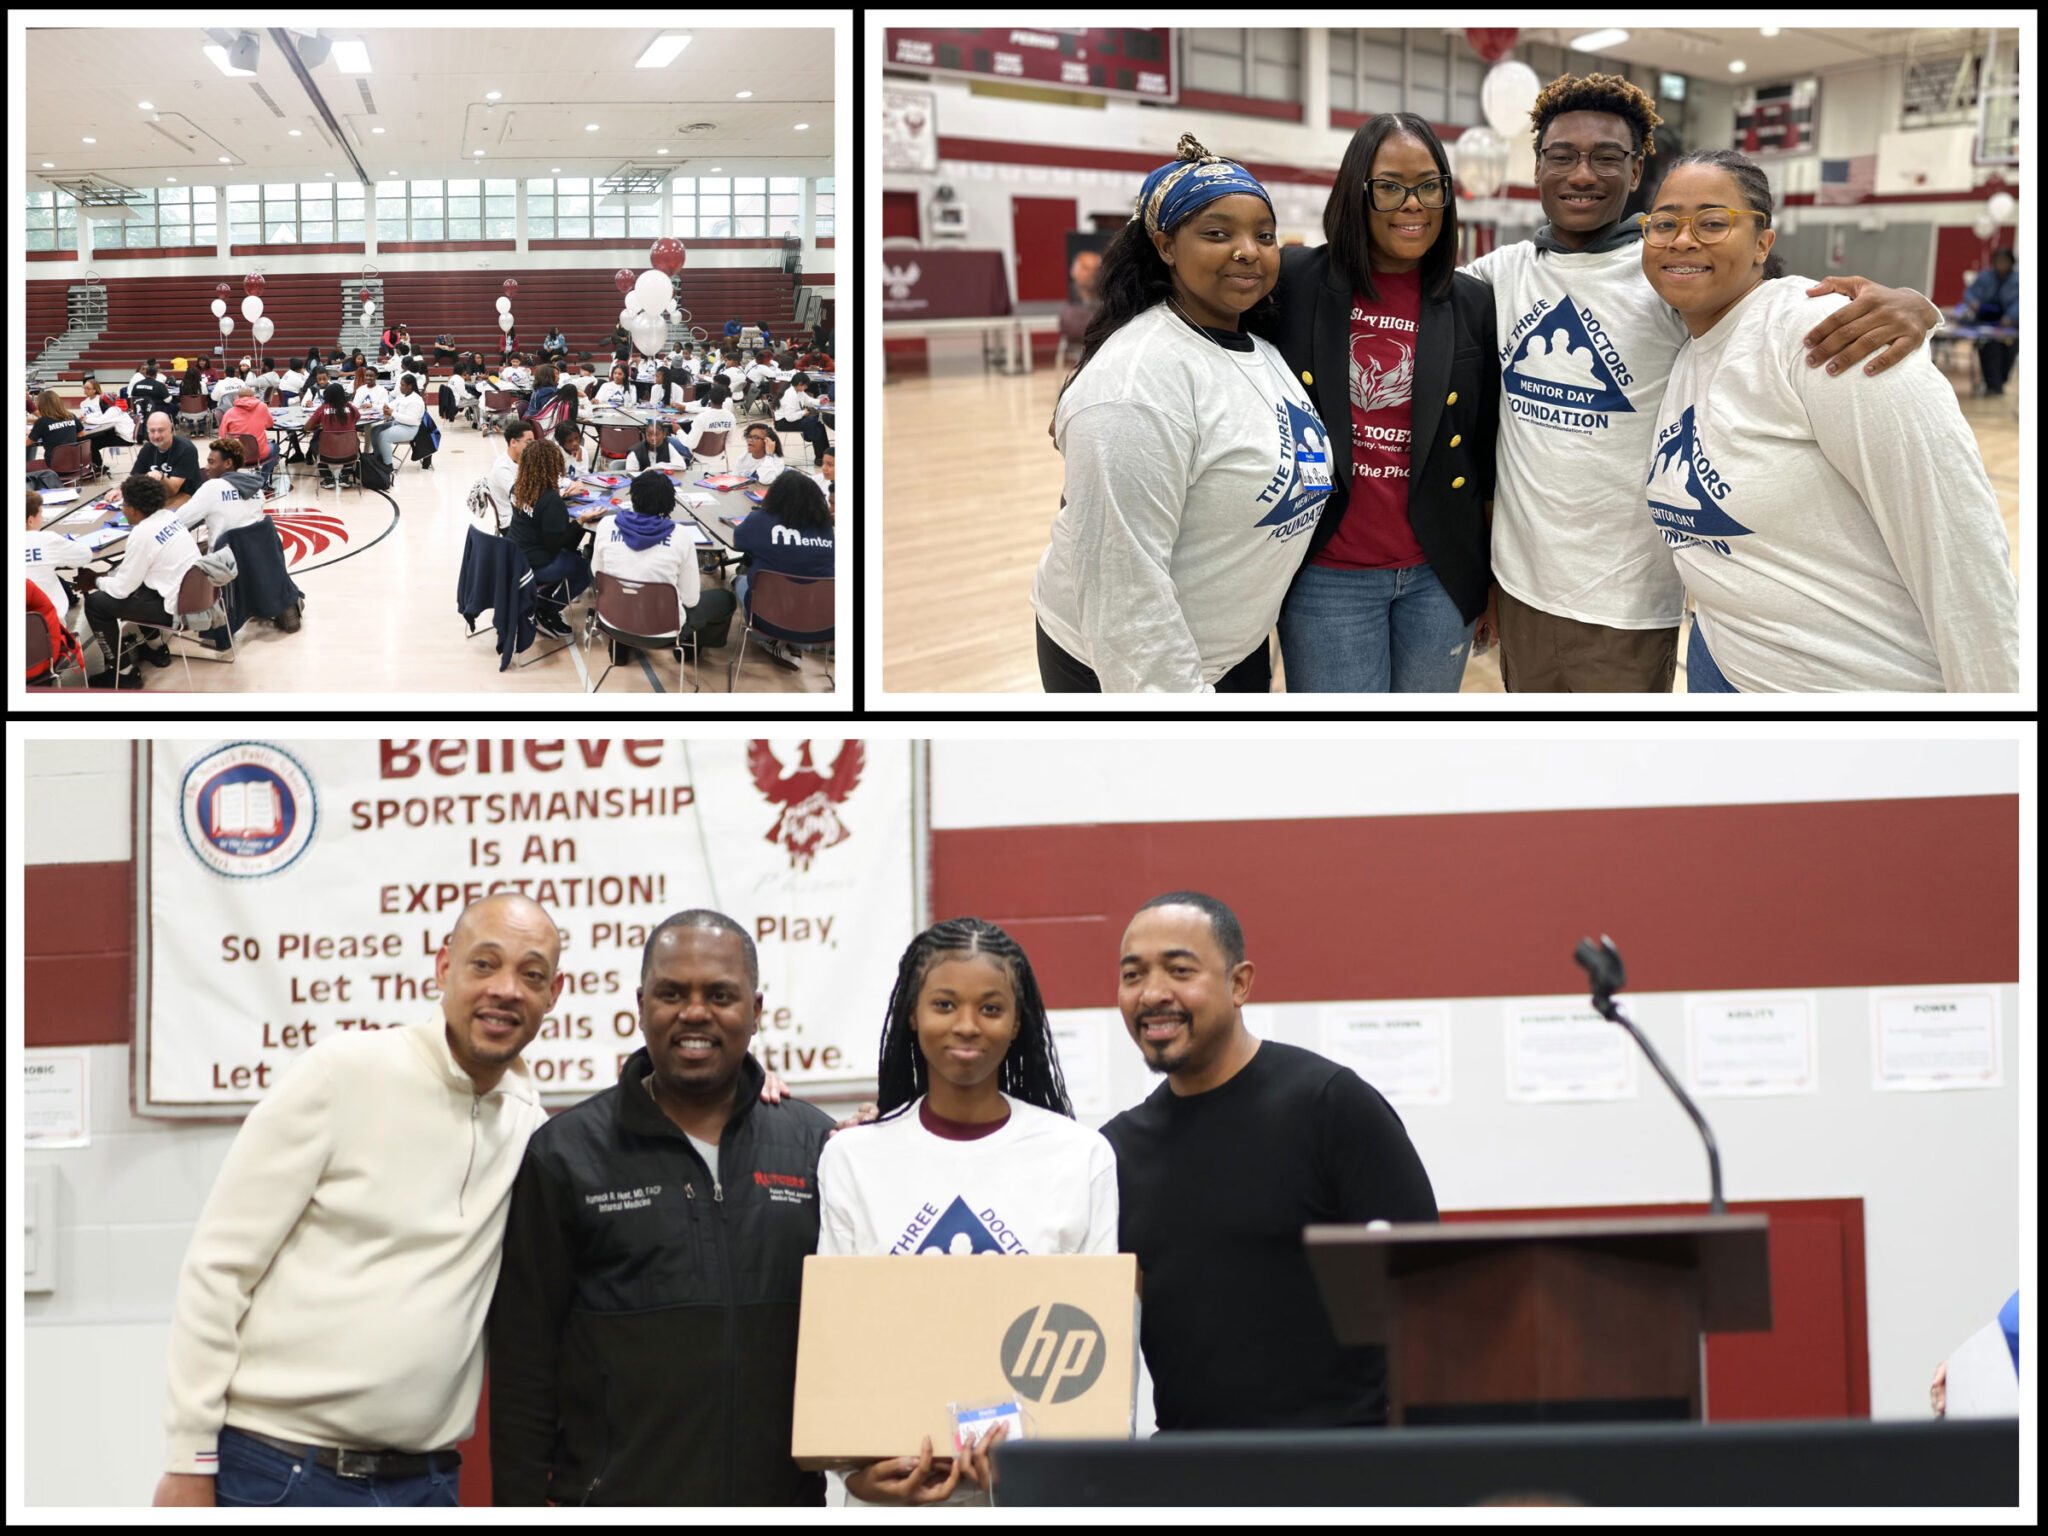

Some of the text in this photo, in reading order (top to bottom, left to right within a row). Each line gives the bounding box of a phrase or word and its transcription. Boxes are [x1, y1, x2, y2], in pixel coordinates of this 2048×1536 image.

[1378, 316, 1415, 332] HIGH
[1511, 299, 1551, 340] THREE
[1580, 307, 1634, 387] DOCTORS
[1520, 380, 1594, 404] MENTOR DAY
[1508, 396, 1608, 429] OUNDATION
[1256, 403, 1292, 503] THE THREE
[1358, 464, 1381, 477] the
[1677, 515, 1695, 528] DAY
[379, 738, 665, 780] Believe
[351, 786, 696, 831] SPORTSMANSHIP
[470, 834, 576, 866] Is An
[221, 934, 260, 961] So
[278, 932, 402, 959] Please
[757, 916, 837, 949] Play,
[291, 975, 352, 1003] Let
[263, 1020, 317, 1048] Let
[212, 1061, 272, 1089] Let
[889, 1201, 939, 1256] THREE
[1010, 1303, 1097, 1403] hp
